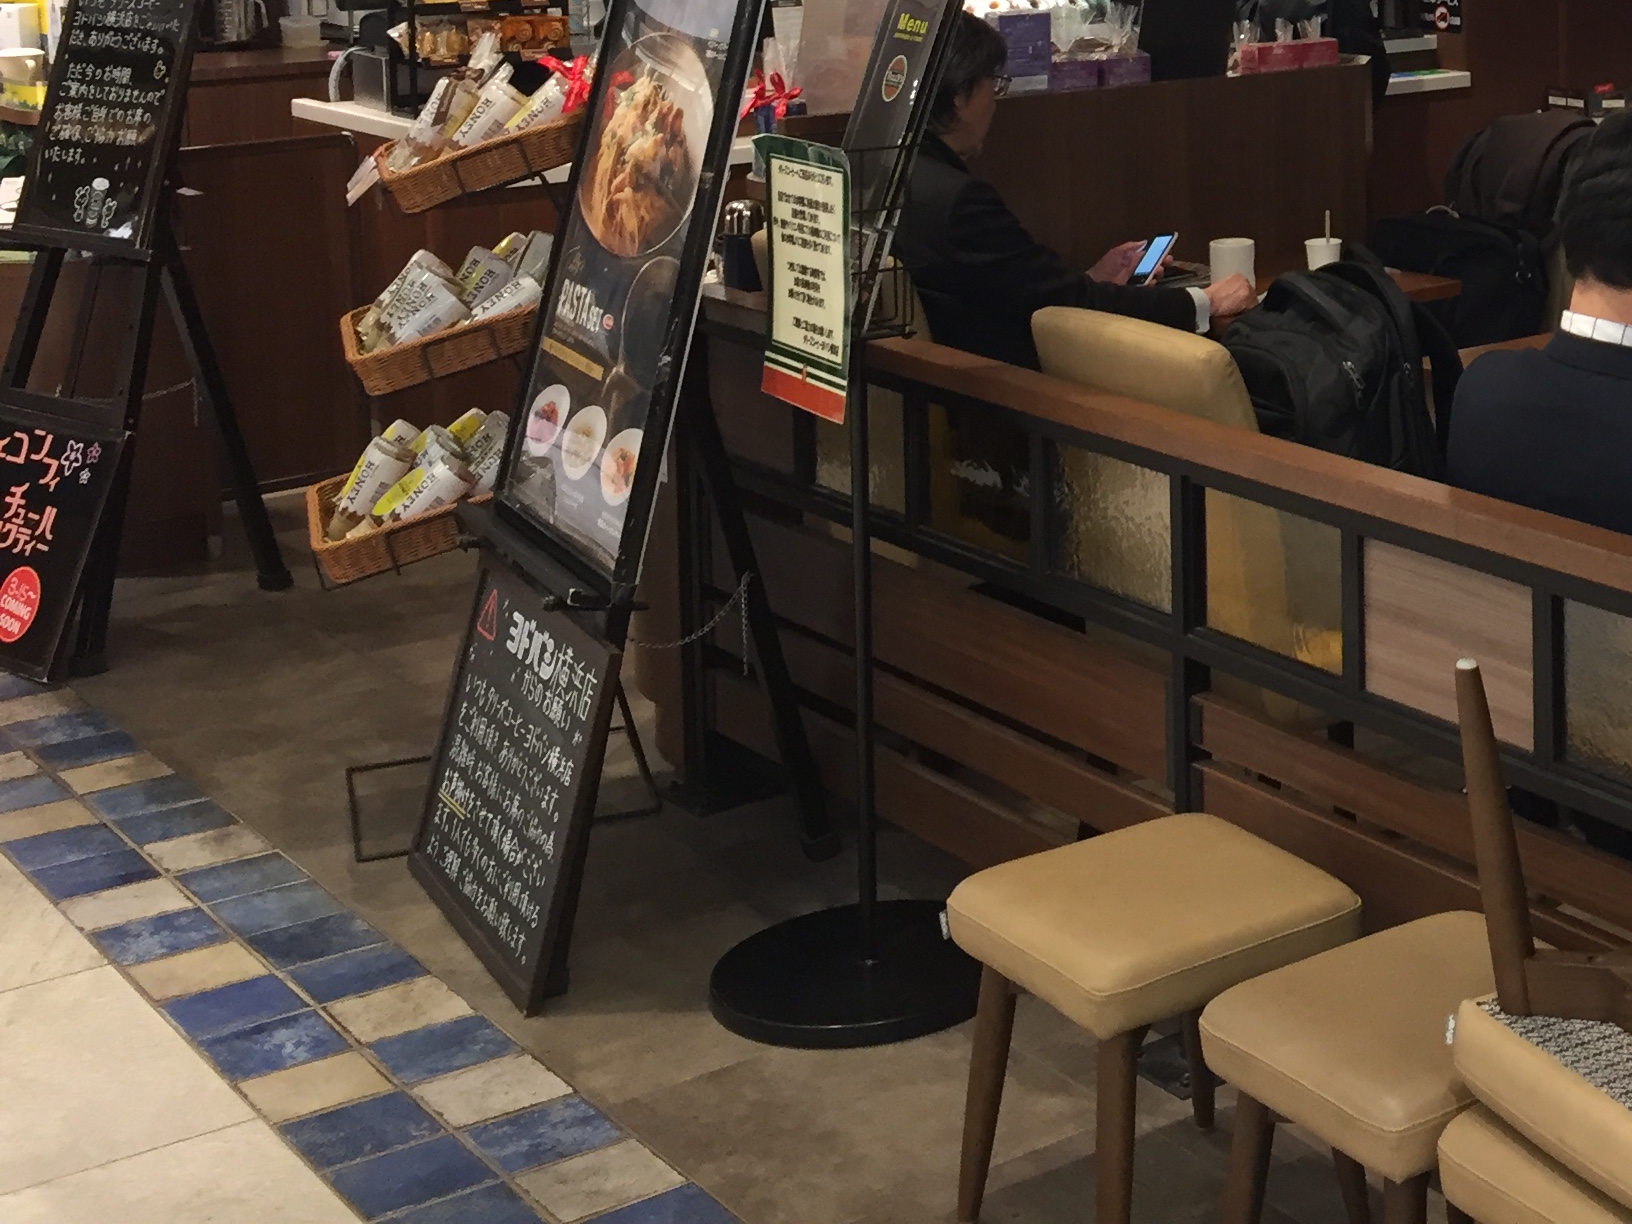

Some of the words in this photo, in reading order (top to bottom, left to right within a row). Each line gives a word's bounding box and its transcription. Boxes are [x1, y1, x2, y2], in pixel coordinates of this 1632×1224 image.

[897, 13, 929, 34] Menu
[460, 96, 494, 138] HONEY
[516, 95, 552, 132] HONEY
[480, 280, 524, 315] HONEY
[556, 278, 595, 327] PASTA
[347, 460, 375, 506] HONEY
[402, 472, 437, 513] HONEY
[0, 594, 32, 621] COMING
[505, 609, 598, 722] ヨドバシ横浜店
